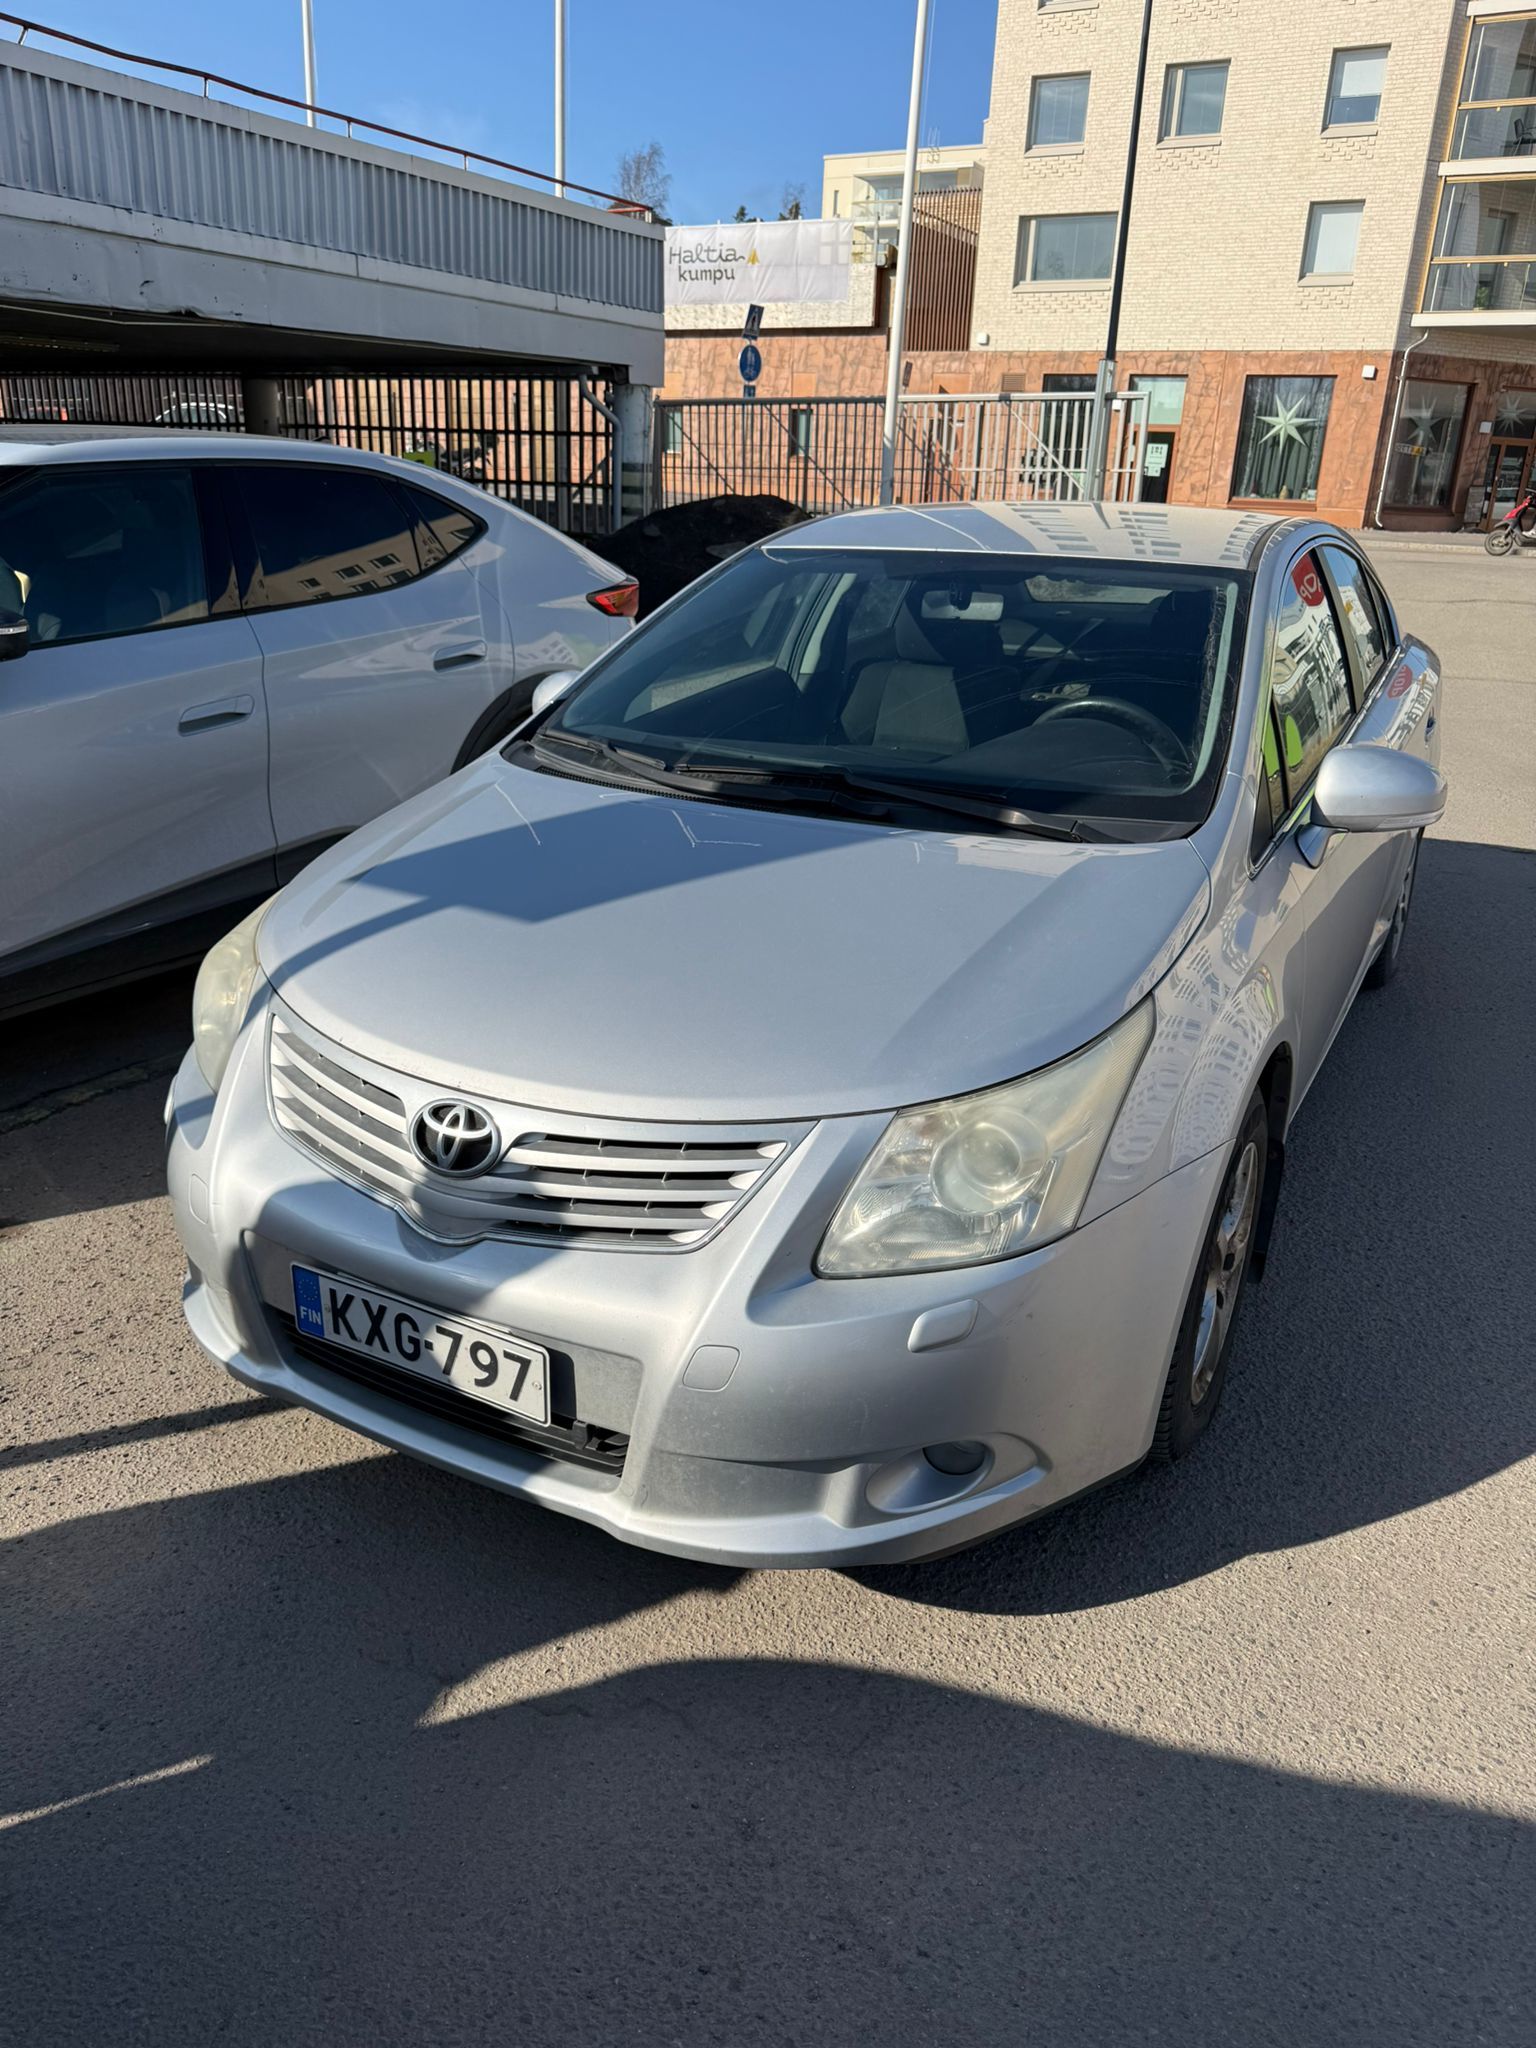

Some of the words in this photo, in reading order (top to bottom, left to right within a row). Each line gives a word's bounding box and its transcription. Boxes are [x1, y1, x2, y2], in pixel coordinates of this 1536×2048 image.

[669, 243, 745, 264] Haltia
[678, 265, 735, 285] kumpu
[300, 1305, 321, 1325] FIN
[329, 1288, 532, 1401] KXG-797
